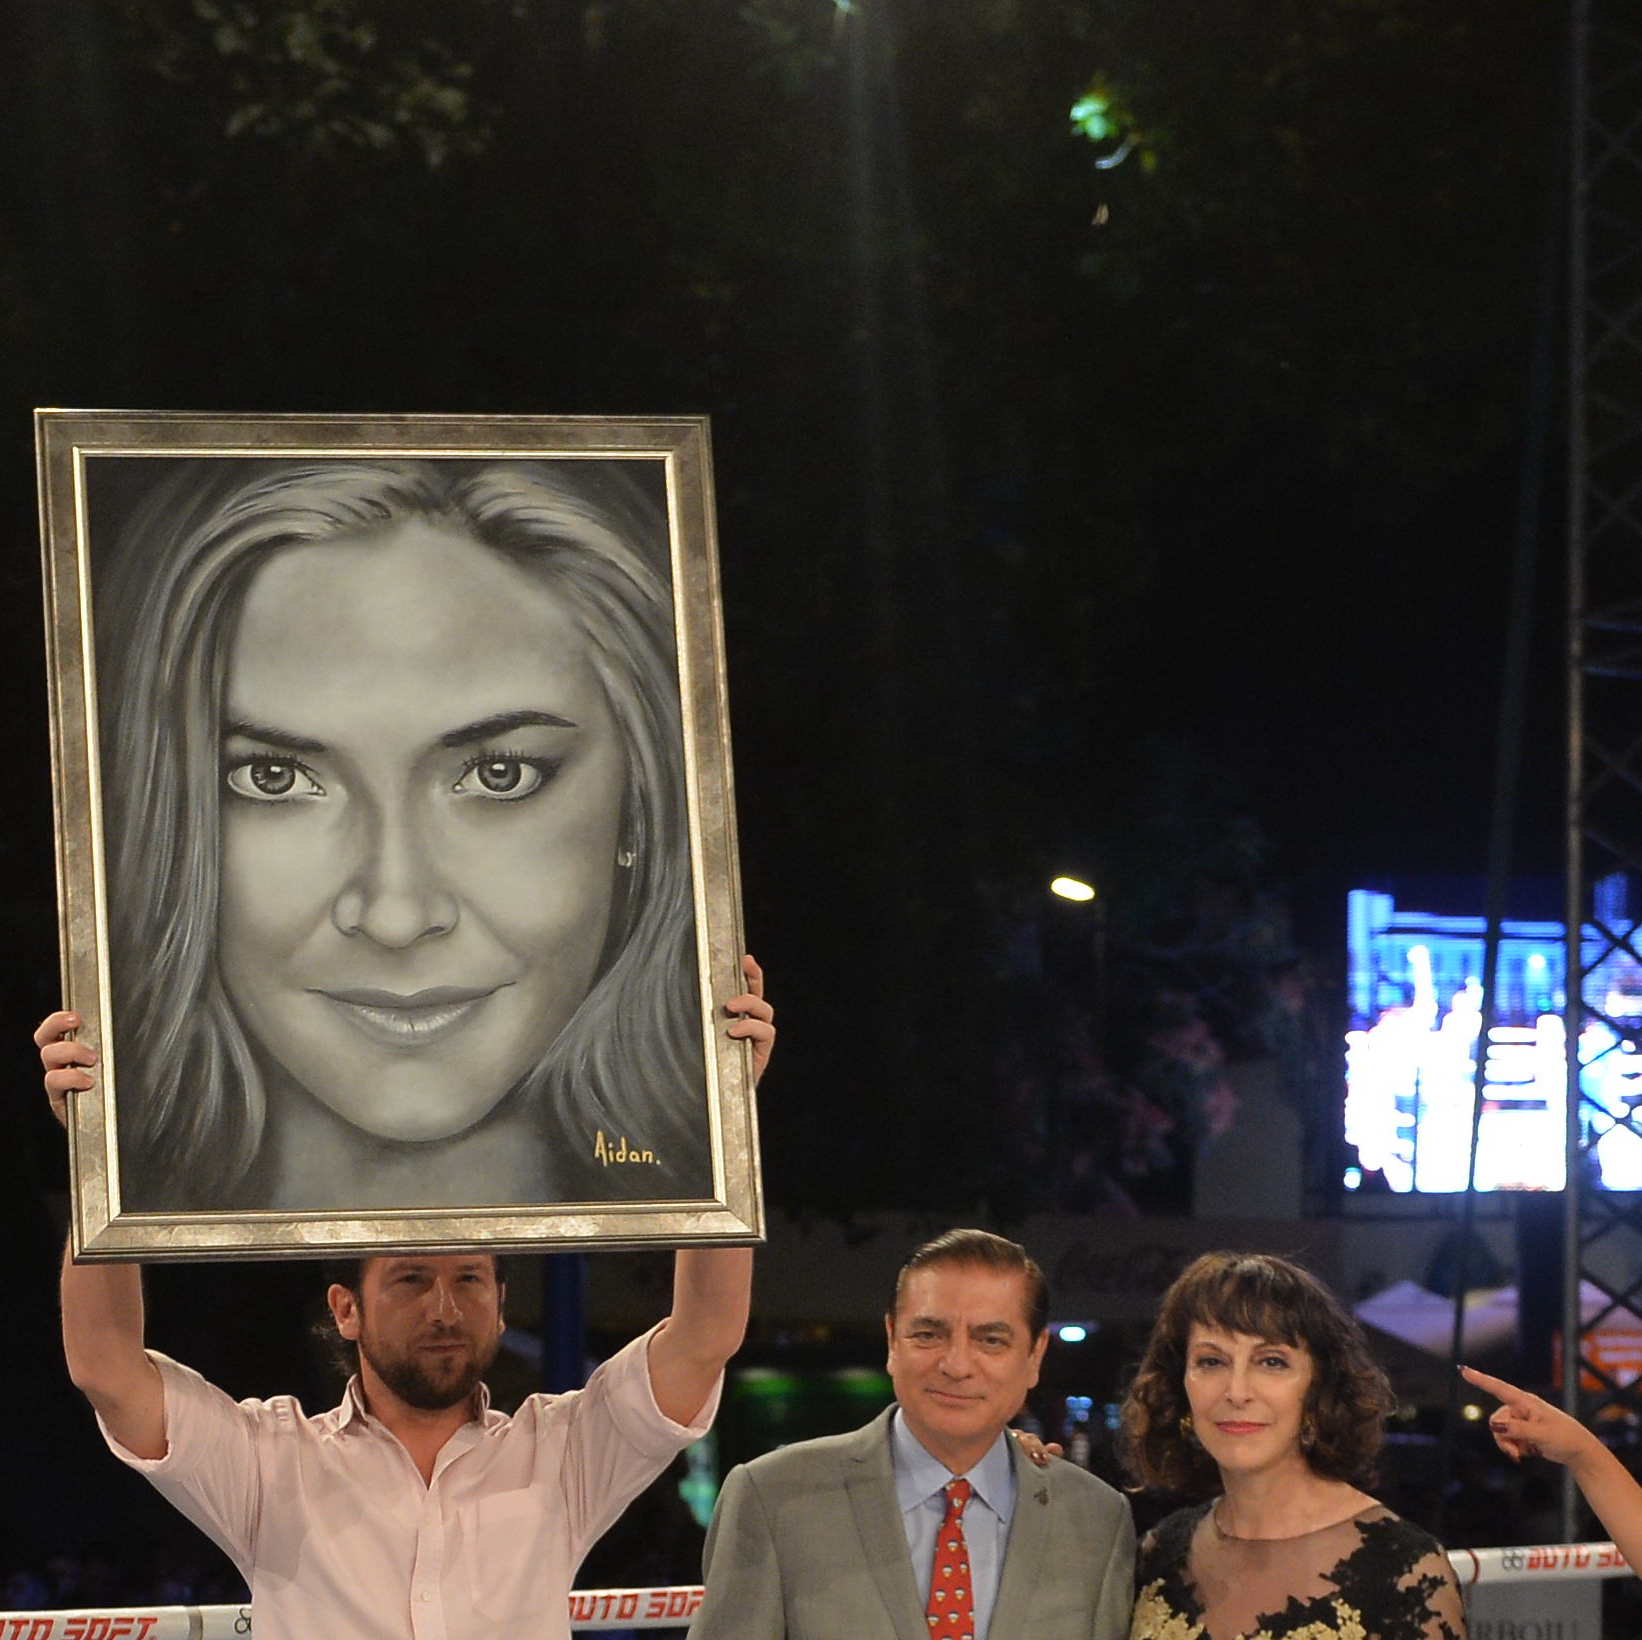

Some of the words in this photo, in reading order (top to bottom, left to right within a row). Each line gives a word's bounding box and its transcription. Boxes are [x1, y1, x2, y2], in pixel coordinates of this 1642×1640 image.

[594, 1131, 661, 1167] Aidan.
[1527, 1546, 1591, 1571] AUTO
[1597, 1539, 1629, 1568] SO
[567, 1593, 640, 1622] UTO
[645, 1589, 706, 1618] SOF
